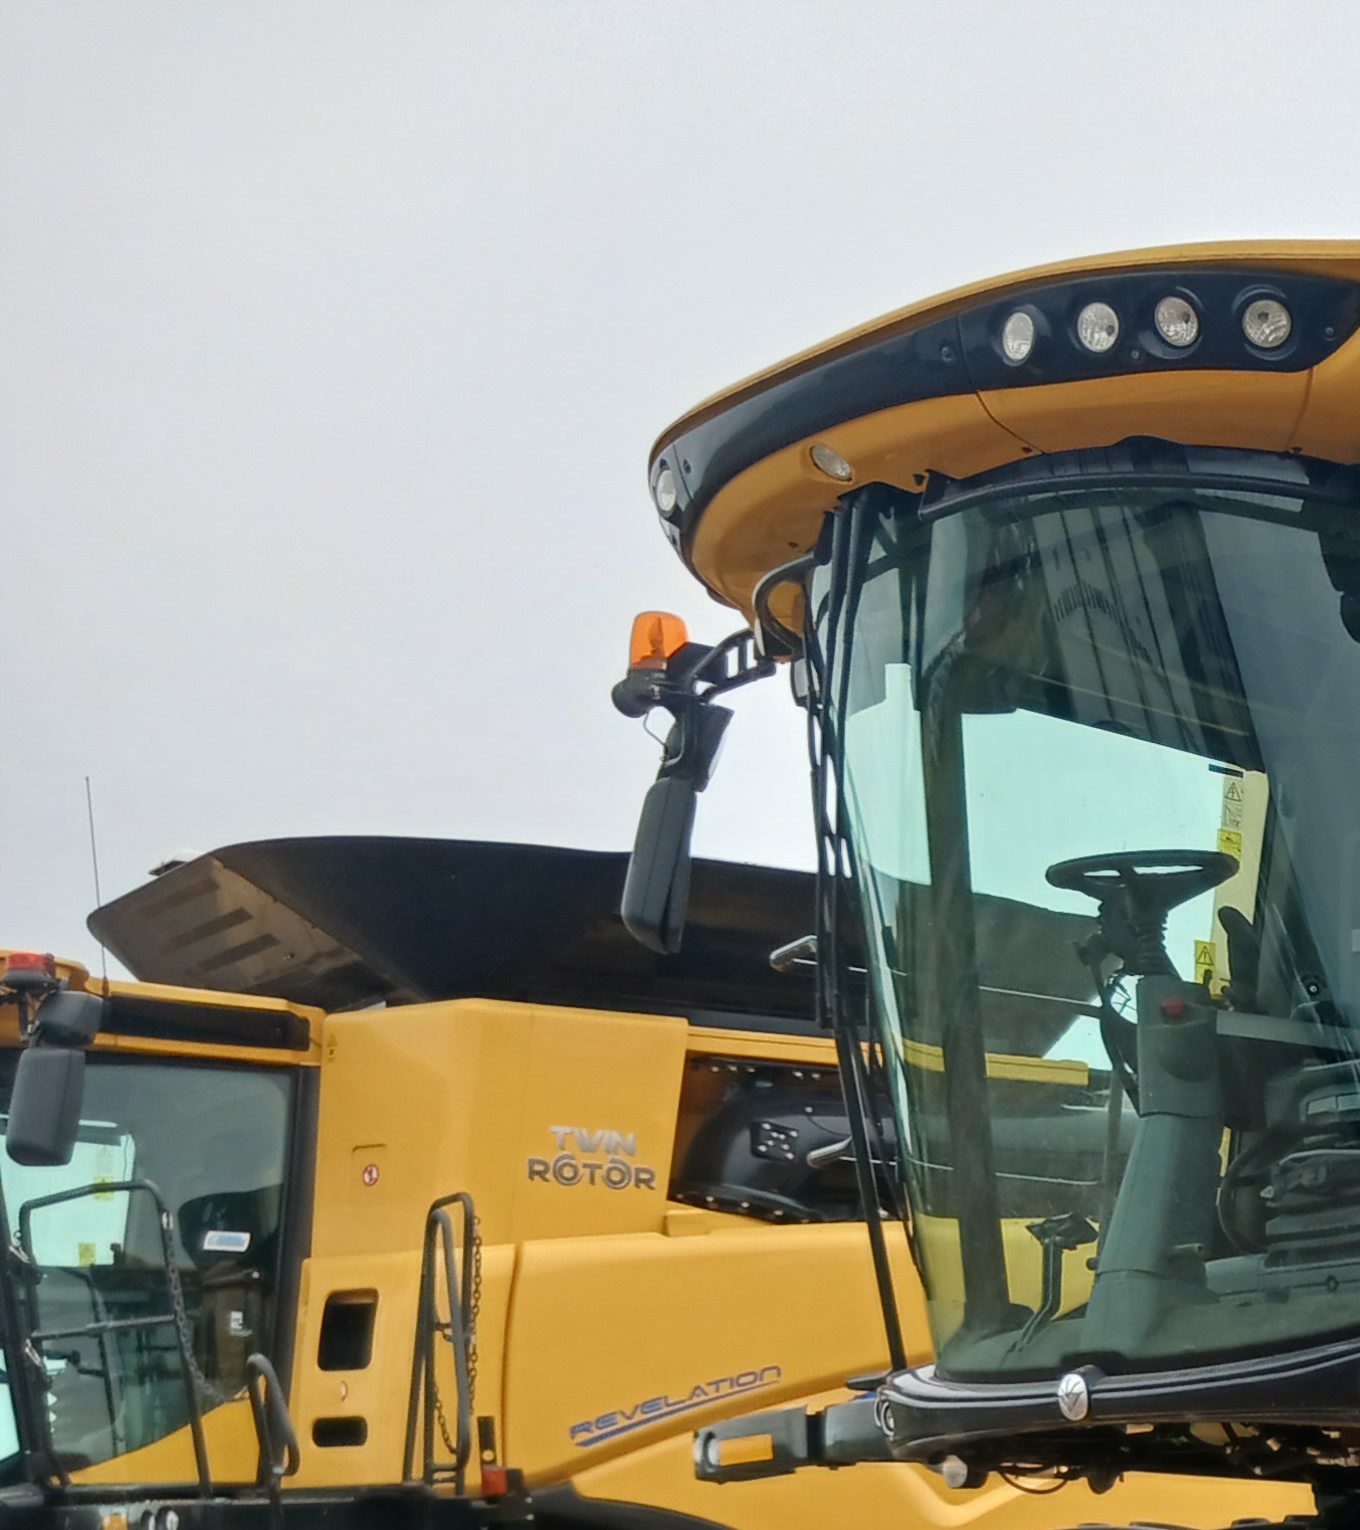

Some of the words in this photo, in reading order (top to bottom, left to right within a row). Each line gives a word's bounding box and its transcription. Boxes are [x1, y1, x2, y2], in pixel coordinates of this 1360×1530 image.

[550, 1125, 637, 1157] TWIN
[526, 1151, 657, 1190] ROTOR
[569, 1365, 782, 1441] REVELATION
